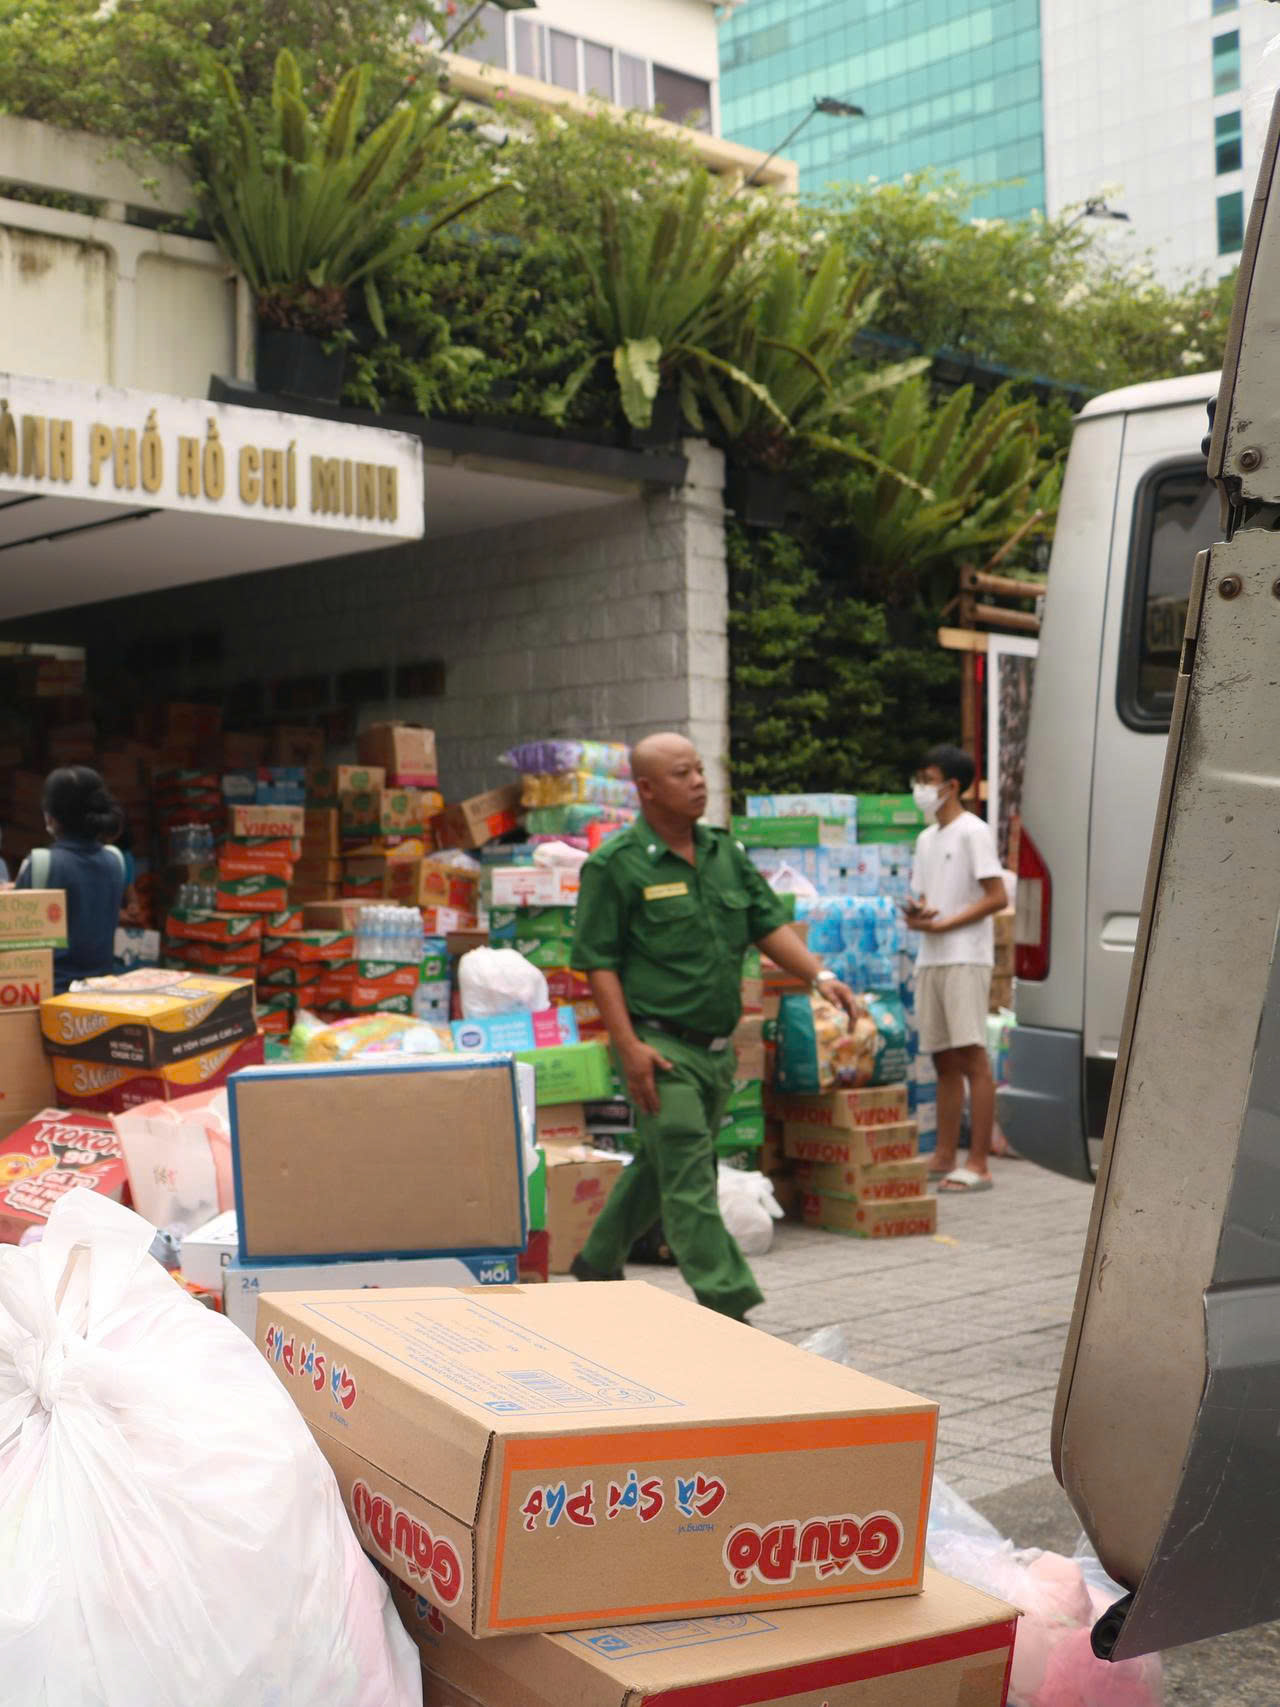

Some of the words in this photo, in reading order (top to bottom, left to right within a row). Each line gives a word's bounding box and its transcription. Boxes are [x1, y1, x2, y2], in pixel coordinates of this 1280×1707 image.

[88, 407, 163, 493] PHỐ
[177, 417, 225, 500] HỒ
[239, 439, 297, 509] CHÍ
[310, 454, 399, 522] MINH
[242, 1277, 259, 1289] 24
[265, 1327, 295, 1376] Phở
[331, 1366, 356, 1410] Gà
[523, 1482, 596, 1531] Phở
[608, 1470, 663, 1522] Sợi
[676, 1473, 726, 1517] Gà
[394, 1510, 462, 1602] Gấu
[726, 1525, 796, 1585] Đỏ
[799, 1515, 900, 1575] Gấu
